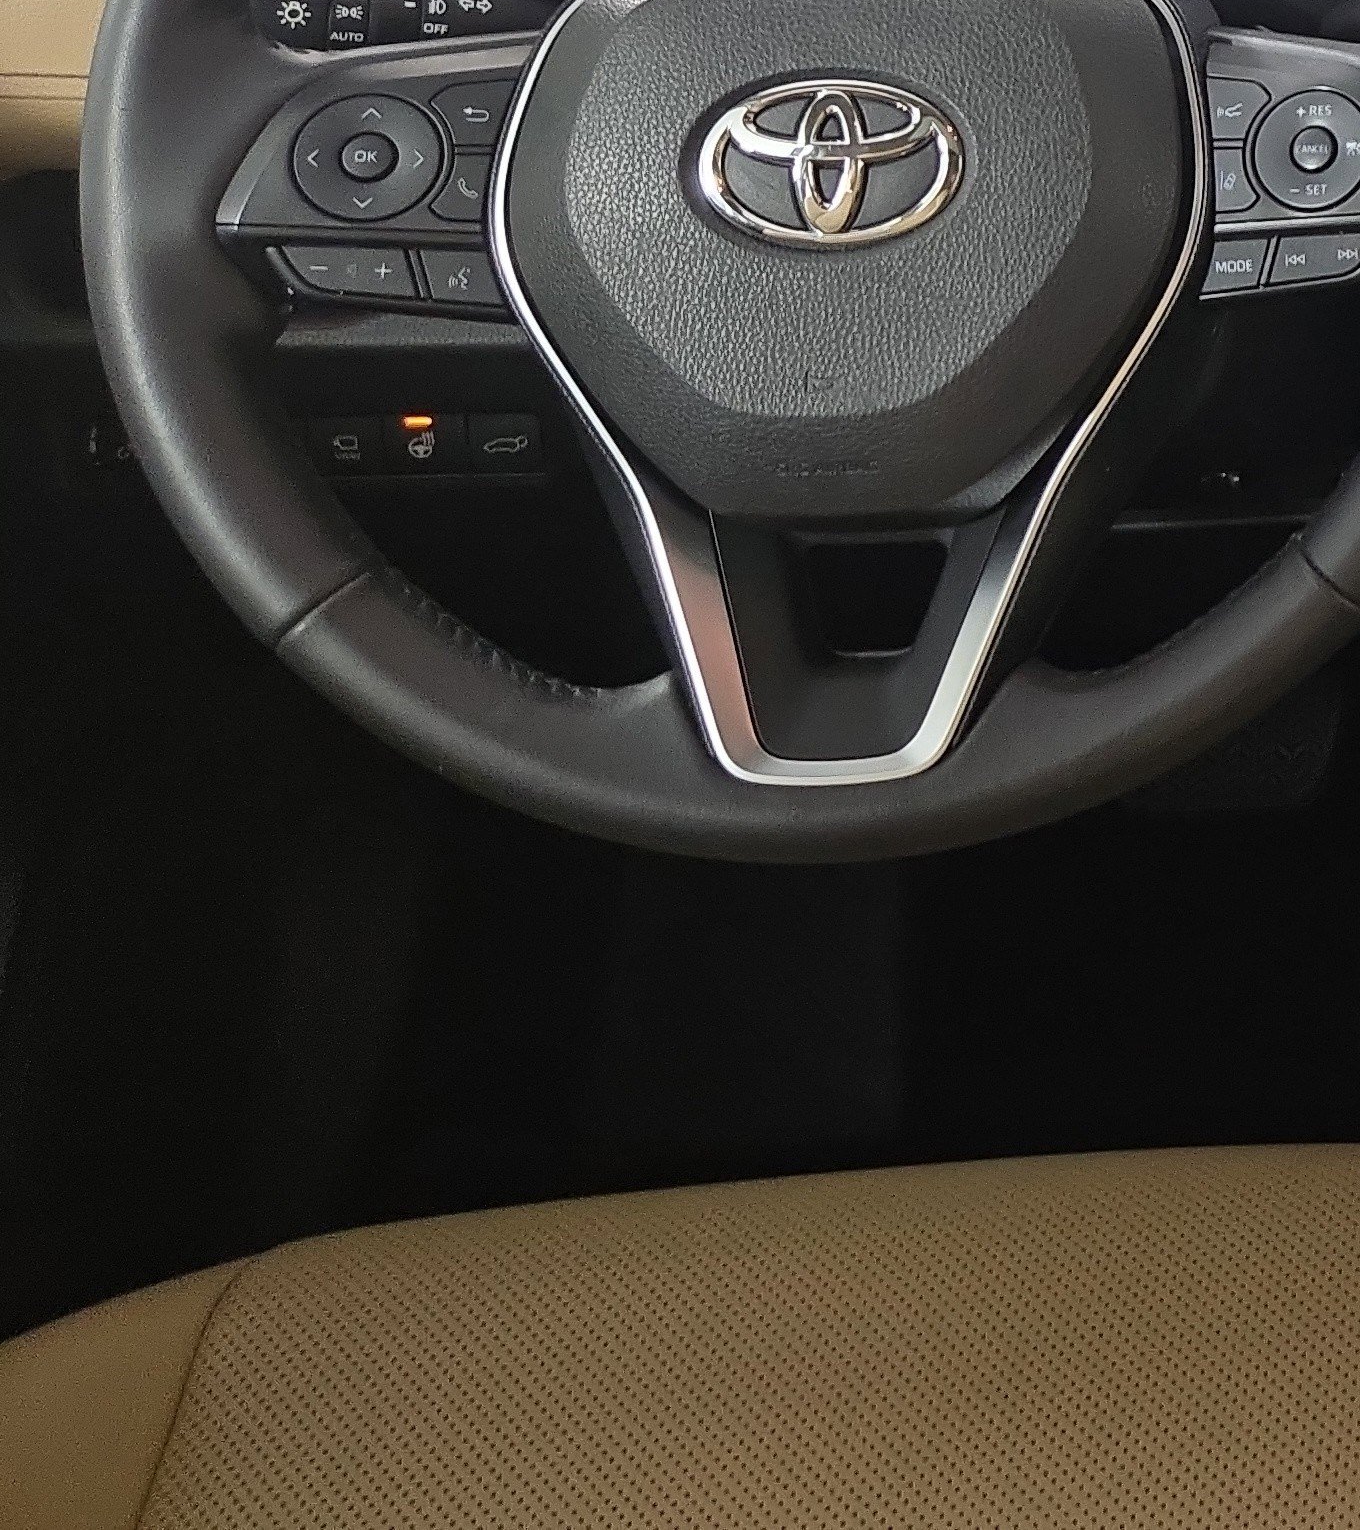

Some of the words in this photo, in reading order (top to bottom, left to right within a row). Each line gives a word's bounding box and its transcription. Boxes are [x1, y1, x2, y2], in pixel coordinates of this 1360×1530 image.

[423, 22, 450, 35] OFF
[329, 31, 365, 43] AUTO
[1308, 104, 1333, 117] RES
[354, 149, 379, 163] OK
[1304, 183, 1328, 196] SET
[1214, 258, 1253, 274] MODE
